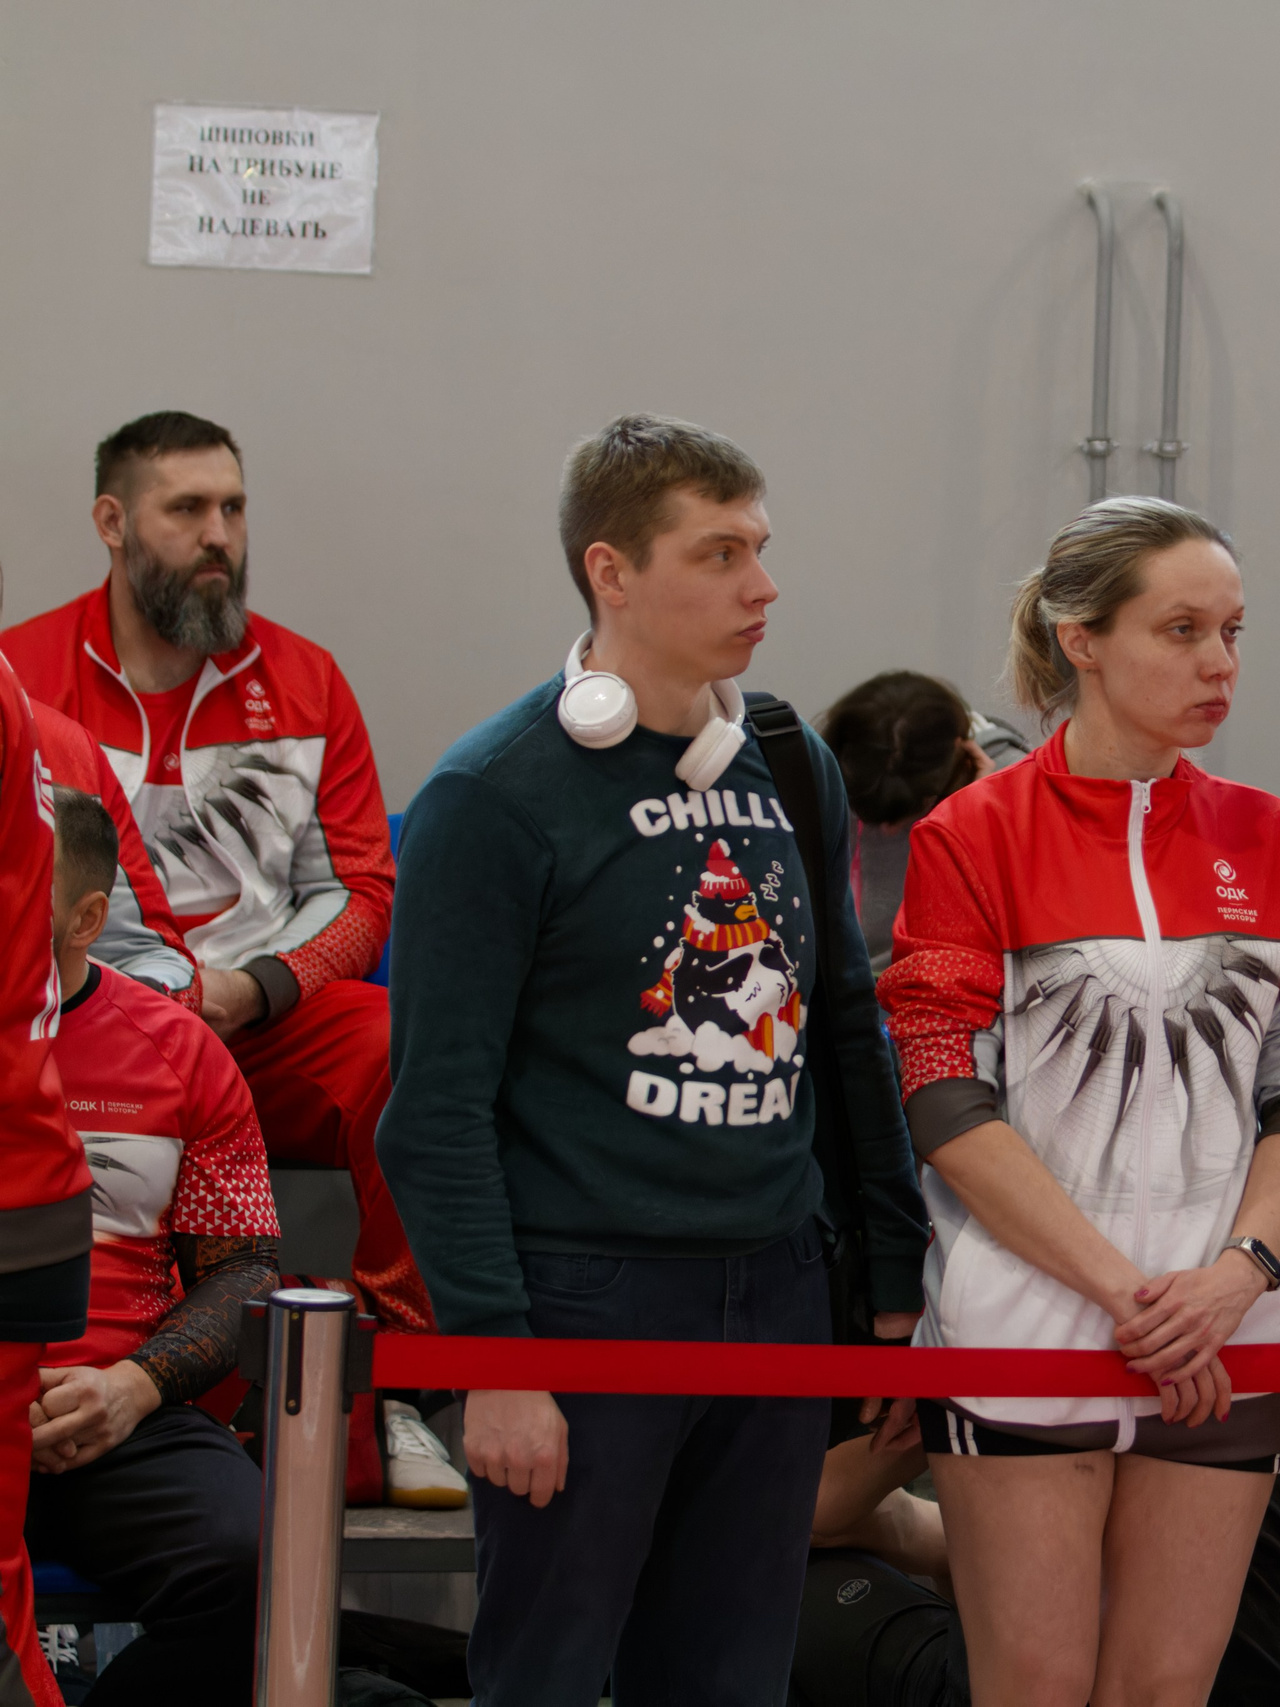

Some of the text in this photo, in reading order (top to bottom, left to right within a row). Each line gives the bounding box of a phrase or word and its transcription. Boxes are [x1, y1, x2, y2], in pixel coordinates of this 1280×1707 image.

[200, 126, 315, 146] ШИПОВКИ
[189, 154, 343, 179] НА ТРИБУНЕ
[242, 188, 271, 205] НЕ
[198, 216, 328, 239] НАДЕВАТЬ
[1216, 886, 1249, 900] ОДК
[1217, 907, 1258, 916] ПЕРМСКИЕ
[1223, 914, 1256, 923] МОТОРЫ
[69, 1100, 98, 1112] ОДК
[625, 1069, 801, 1126] DREA
